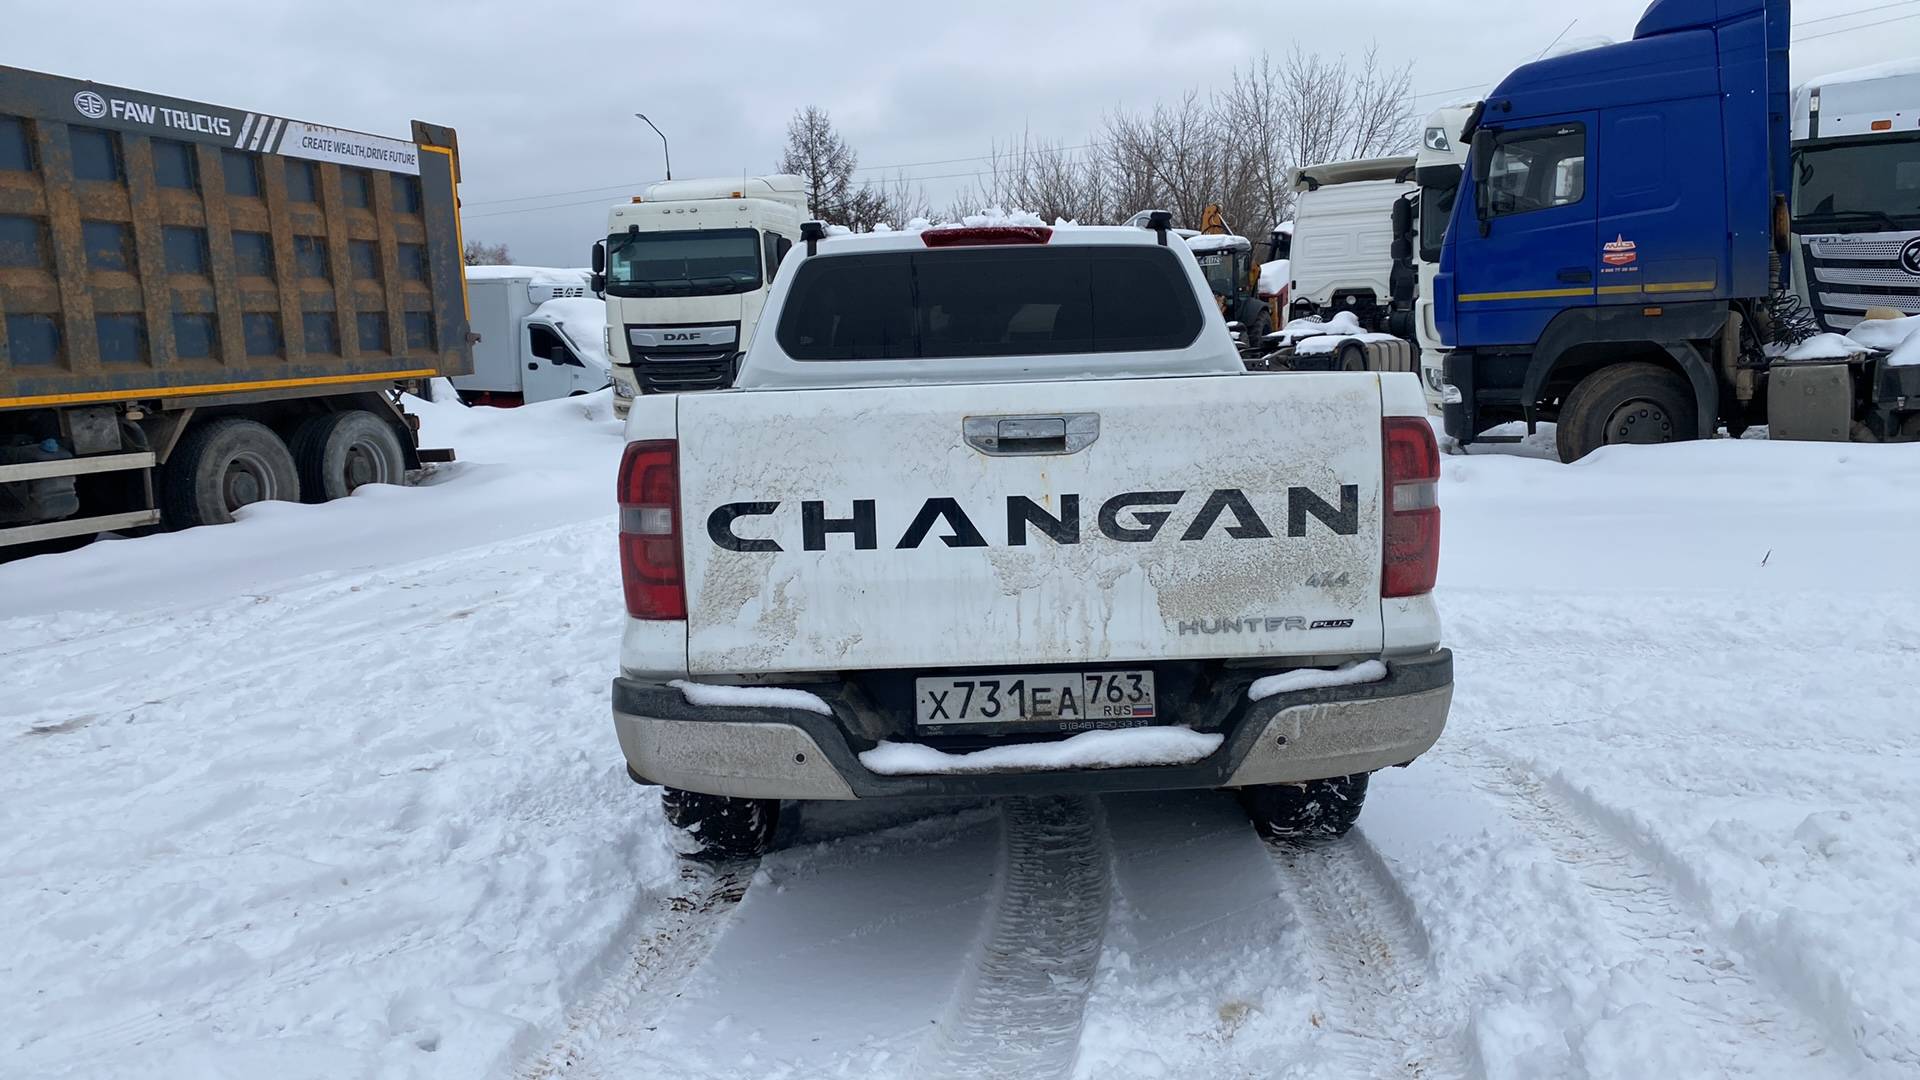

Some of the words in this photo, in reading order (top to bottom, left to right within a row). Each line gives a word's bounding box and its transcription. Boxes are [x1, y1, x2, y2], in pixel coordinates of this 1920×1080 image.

[110, 99, 156, 124] FAW
[159, 107, 231, 136] TRUCKS
[301, 136, 332, 152] CREATE
[389, 150, 416, 165] FUTURE
[663, 333, 702, 341] DAF
[706, 484, 1360, 552] CHANGAN
[1178, 616, 1307, 636] HUNTER
[1311, 619, 1353, 629] PLUS
[1085, 674, 1144, 704] 763
[1103, 704, 1132, 716] RUS
